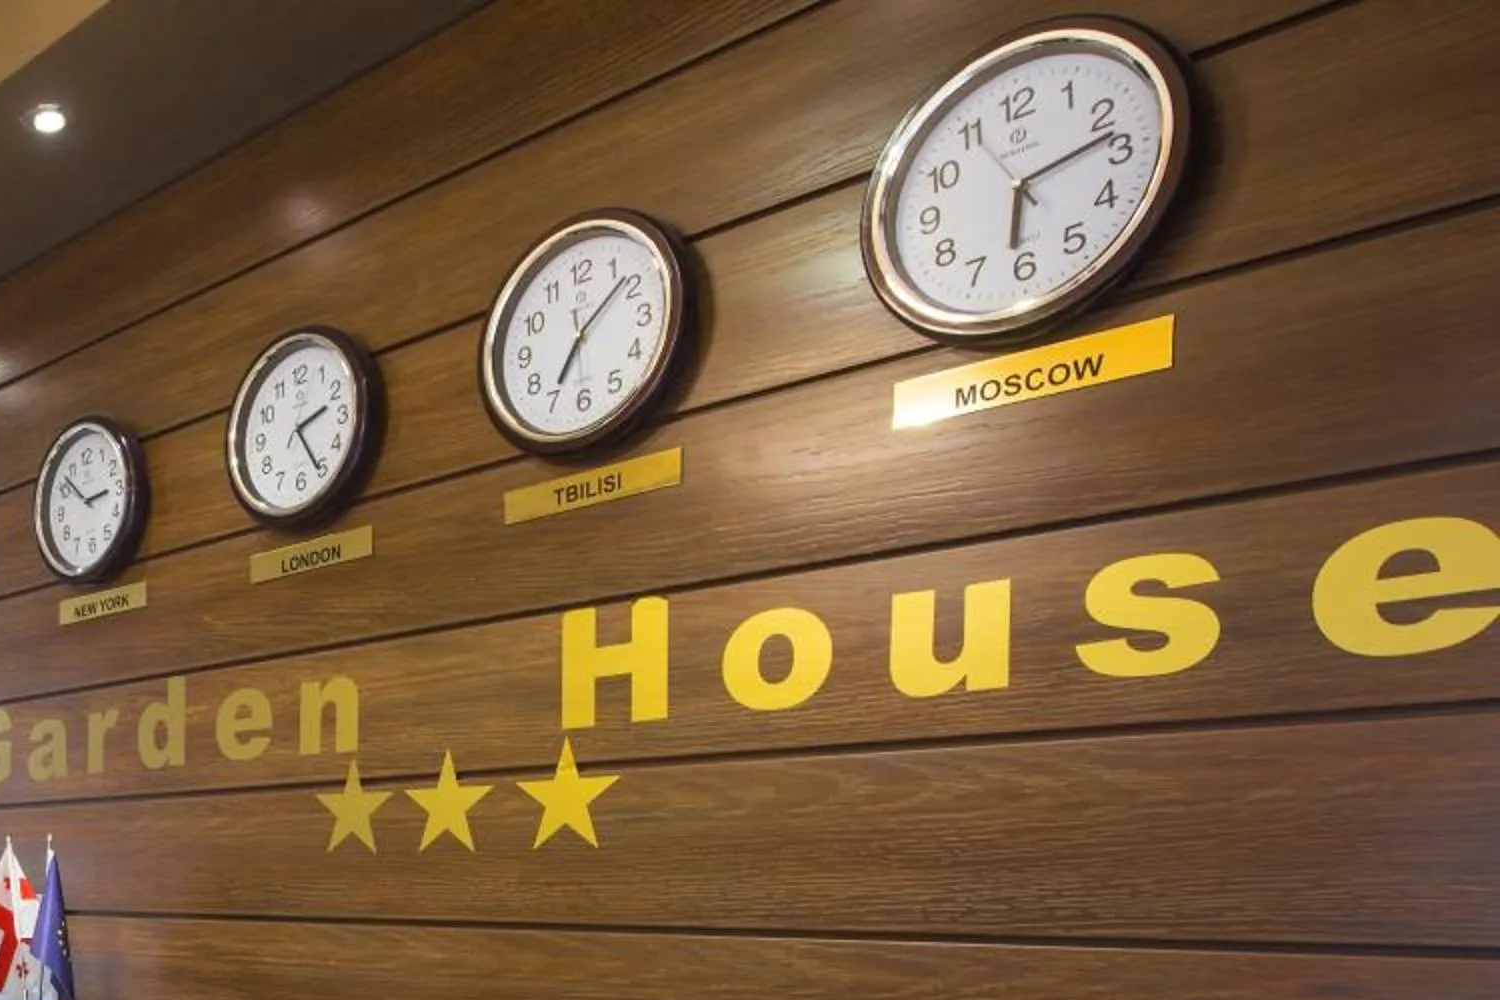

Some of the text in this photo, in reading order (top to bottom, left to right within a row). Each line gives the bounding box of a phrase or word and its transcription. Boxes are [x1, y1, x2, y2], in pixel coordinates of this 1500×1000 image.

[999, 86, 1036, 124] 12
[1061, 80, 1076, 110] 1
[1091, 98, 1115, 133] 2
[958, 118, 983, 151] 11
[1108, 133, 1133, 166] 3
[927, 160, 961, 194] 10
[1094, 179, 1119, 210] 4
[919, 206, 942, 235] 9
[1063, 221, 1087, 255] 5
[935, 238, 957, 267] 8
[569, 258, 593, 286] 12
[607, 257, 618, 279] 1
[965, 256, 988, 289] 7
[1013, 251, 1037, 282] 6
[544, 280, 560, 305] 11
[626, 273, 642, 301] 2
[524, 311, 545, 337] 10
[636, 302, 652, 327] 3
[518, 346, 532, 369] 9
[627, 337, 642, 361] 4
[292, 364, 308, 385] 12
[318, 365, 326, 384] 1
[528, 373, 541, 397] 8
[607, 370, 623, 395] 5
[954, 353, 1105, 410] MOSCOW
[274, 381, 285, 399] 11
[329, 379, 341, 401] 2
[547, 388, 561, 414] 7
[576, 388, 592, 413] 6
[260, 404, 274, 424] 10
[337, 404, 349, 425] 3
[255, 433, 267, 452] 9
[331, 433, 341, 451] 4
[81, 447, 93, 466] 12
[100, 449, 106, 463] 1
[262, 455, 273, 475] 8
[317, 457, 329, 478] 5
[68, 463, 77, 477] 11
[109, 459, 117, 478] 2
[115, 479, 125, 497] 3
[275, 471, 285, 491] 7
[295, 472, 307, 491] 6
[554, 472, 622, 506] TBILISI
[57, 506, 65, 523] 9
[112, 502, 120, 519] 4
[63, 526, 71, 541] 8
[103, 524, 113, 541] 5
[73, 537, 81, 556] 7
[88, 537, 97, 554] 6
[281, 543, 341, 574] LONDON
[74, 594, 129, 618] NEW YORK
[561, 516, 1500, 730] House
